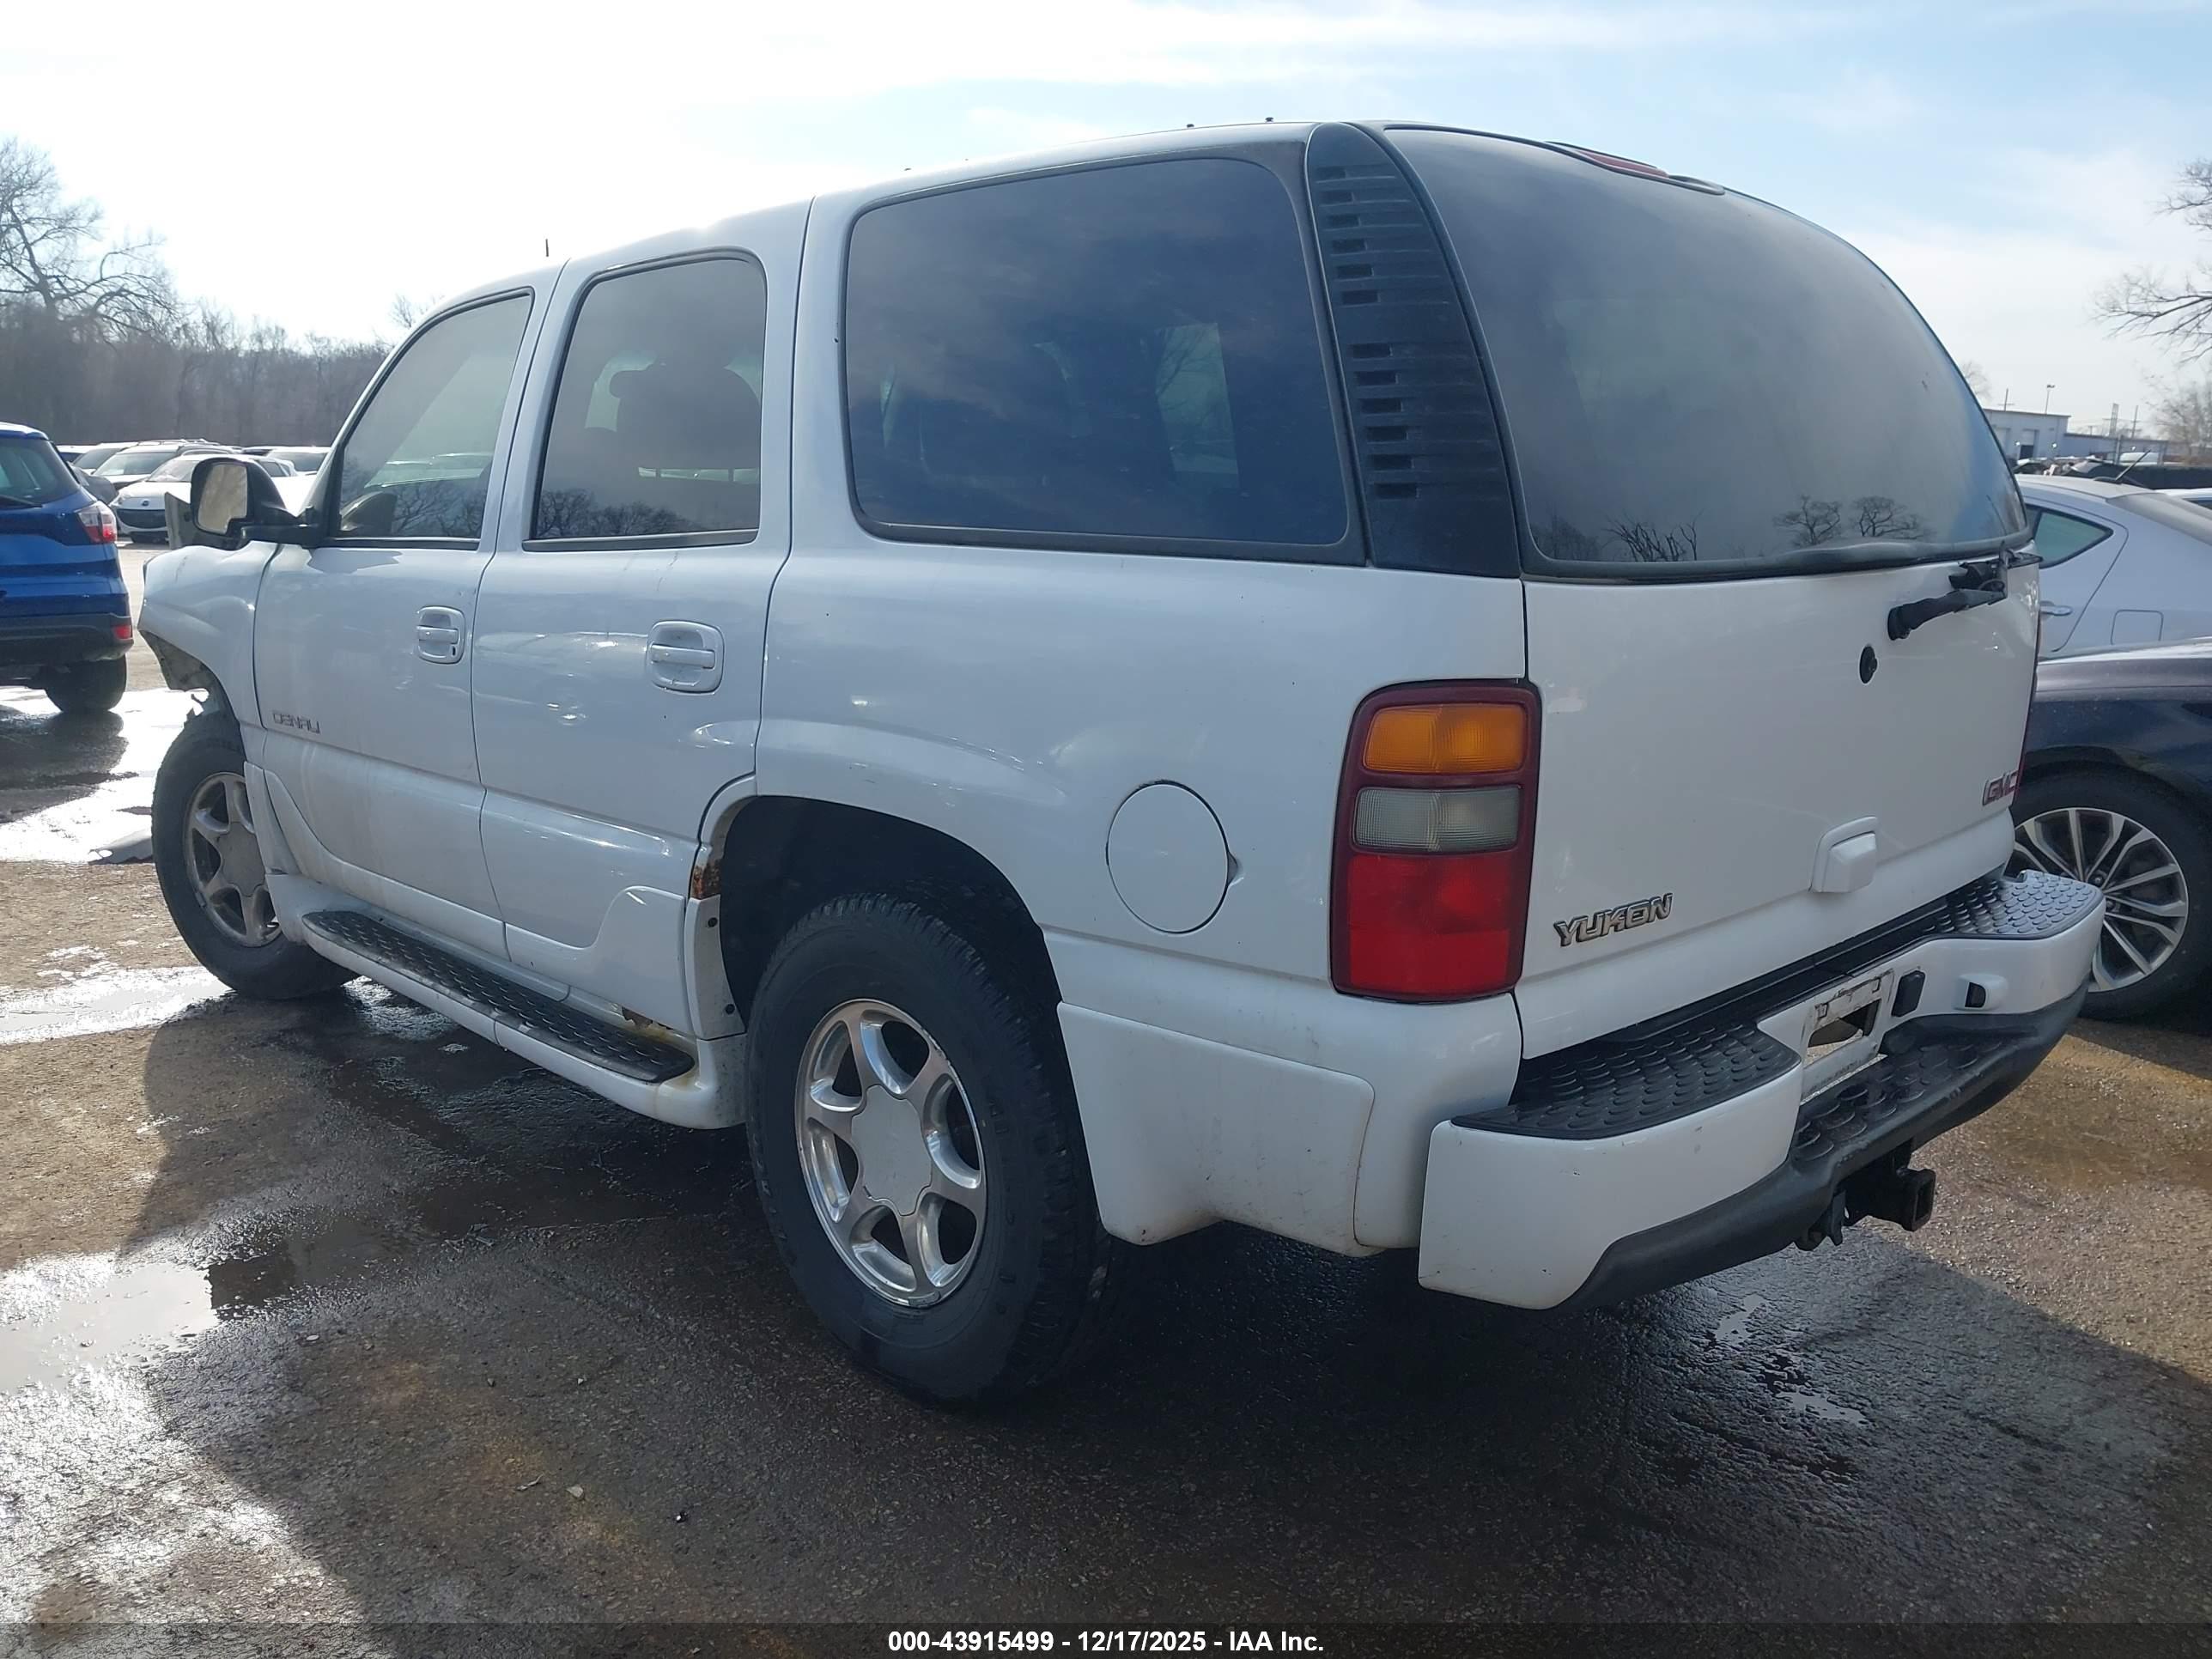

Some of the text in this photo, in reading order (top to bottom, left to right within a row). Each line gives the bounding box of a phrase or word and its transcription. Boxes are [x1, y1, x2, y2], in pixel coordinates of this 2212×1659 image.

[272, 712, 320, 734] DENALI
[1982, 771, 2019, 805] GMC
[1553, 892, 1674, 947] YUKON
